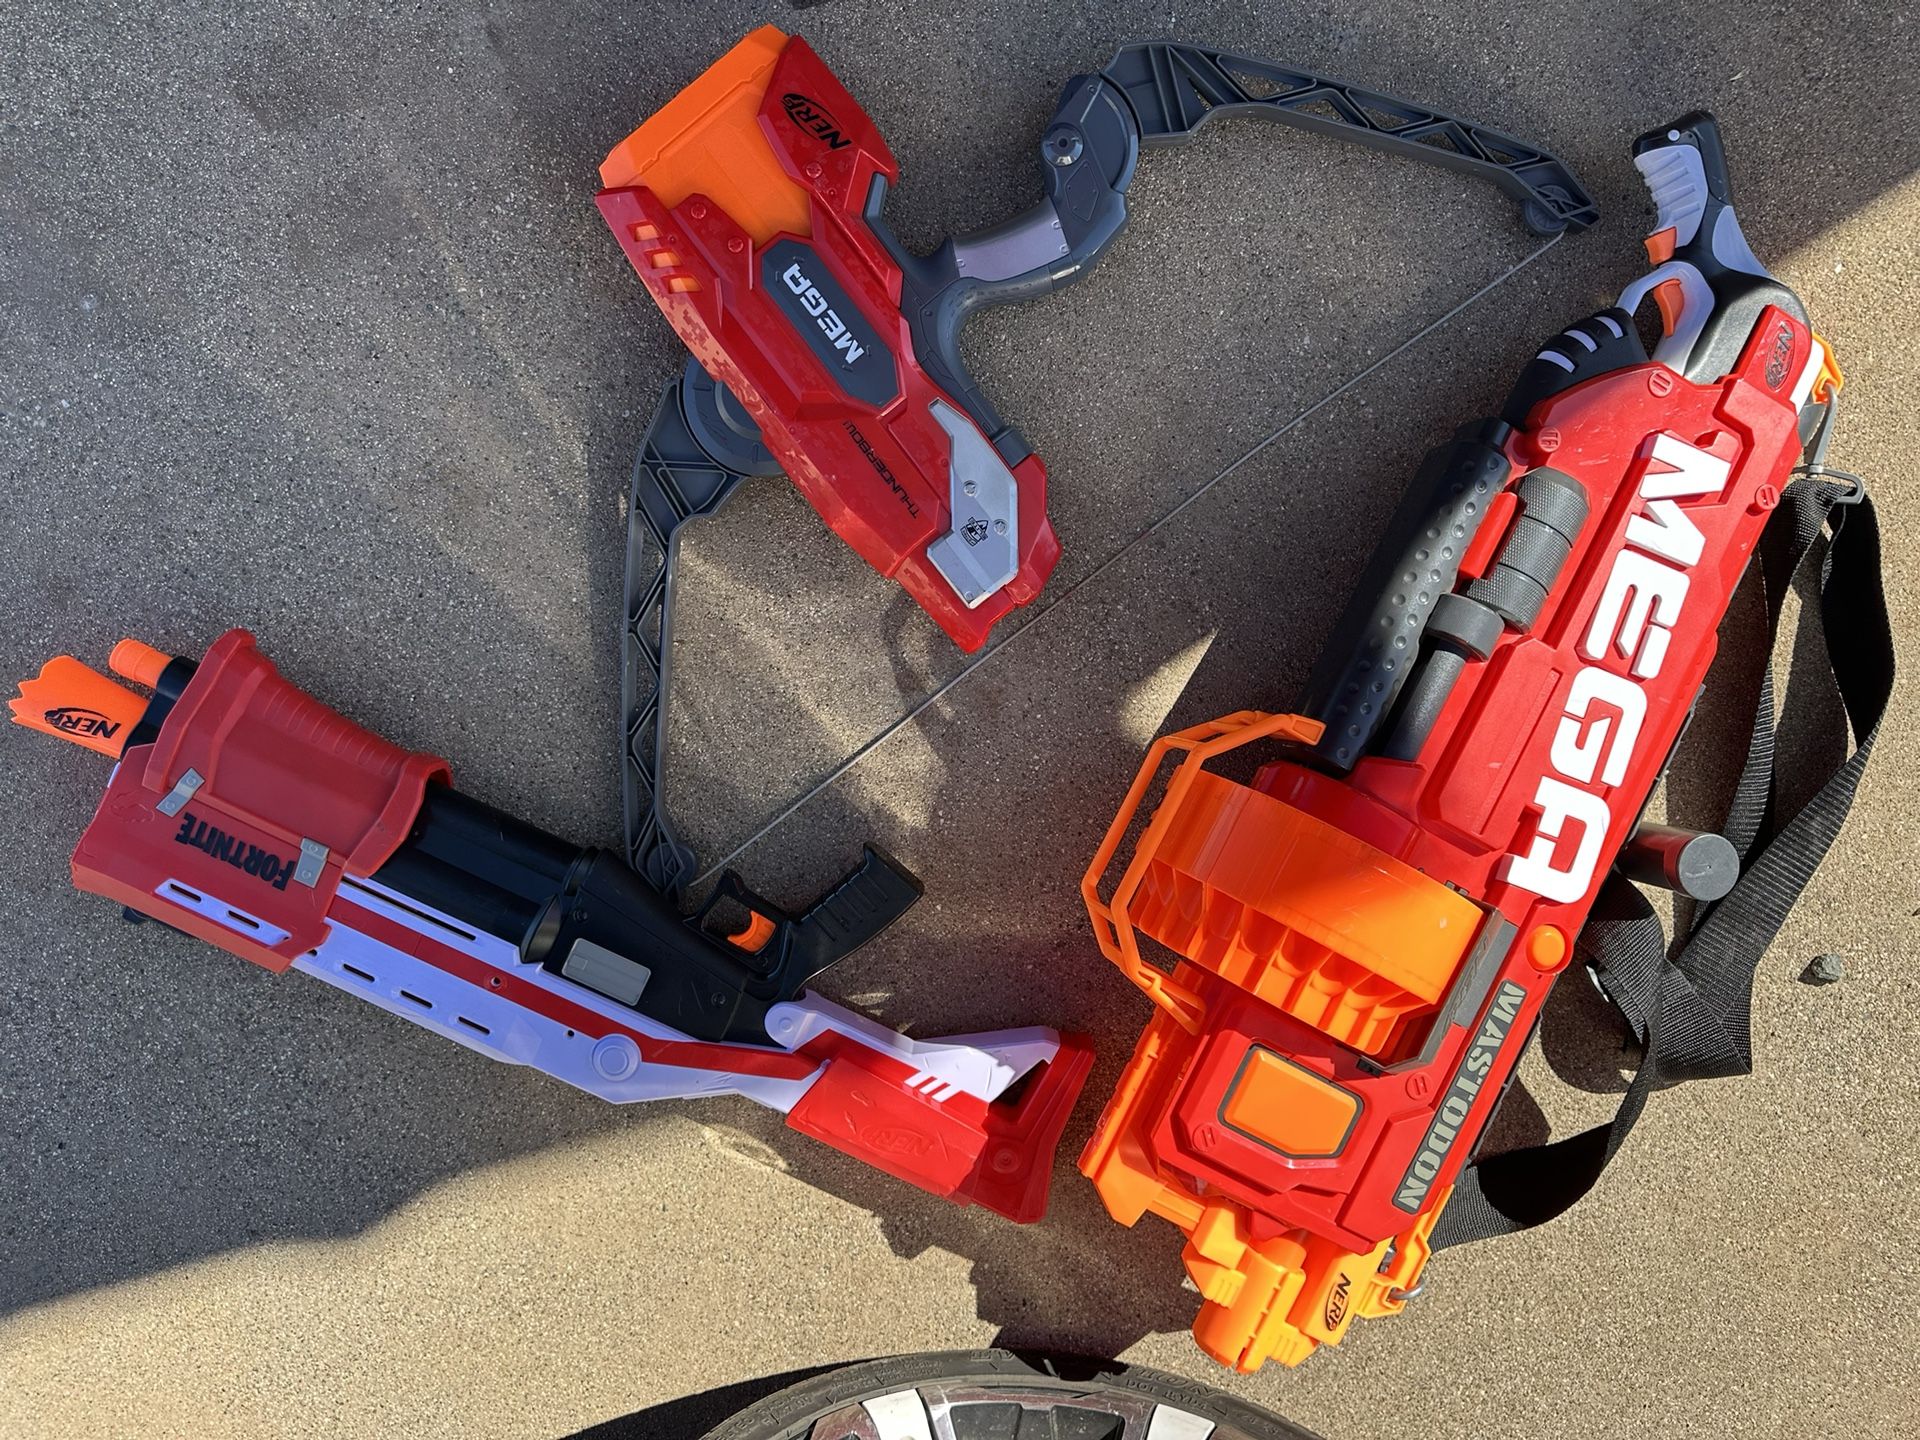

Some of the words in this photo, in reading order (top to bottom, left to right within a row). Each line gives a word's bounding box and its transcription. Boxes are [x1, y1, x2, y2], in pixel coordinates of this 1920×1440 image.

[781, 94, 852, 149] NERF
[782, 263, 865, 364] MEGA
[842, 420, 920, 519] THUNDERBOW
[1502, 433, 1731, 904] MEGA
[44, 709, 121, 739] NERF
[175, 811, 296, 891] FORTNITE
[1397, 982, 1526, 1210] MASTODON
[1326, 1272, 1351, 1331] NERF
